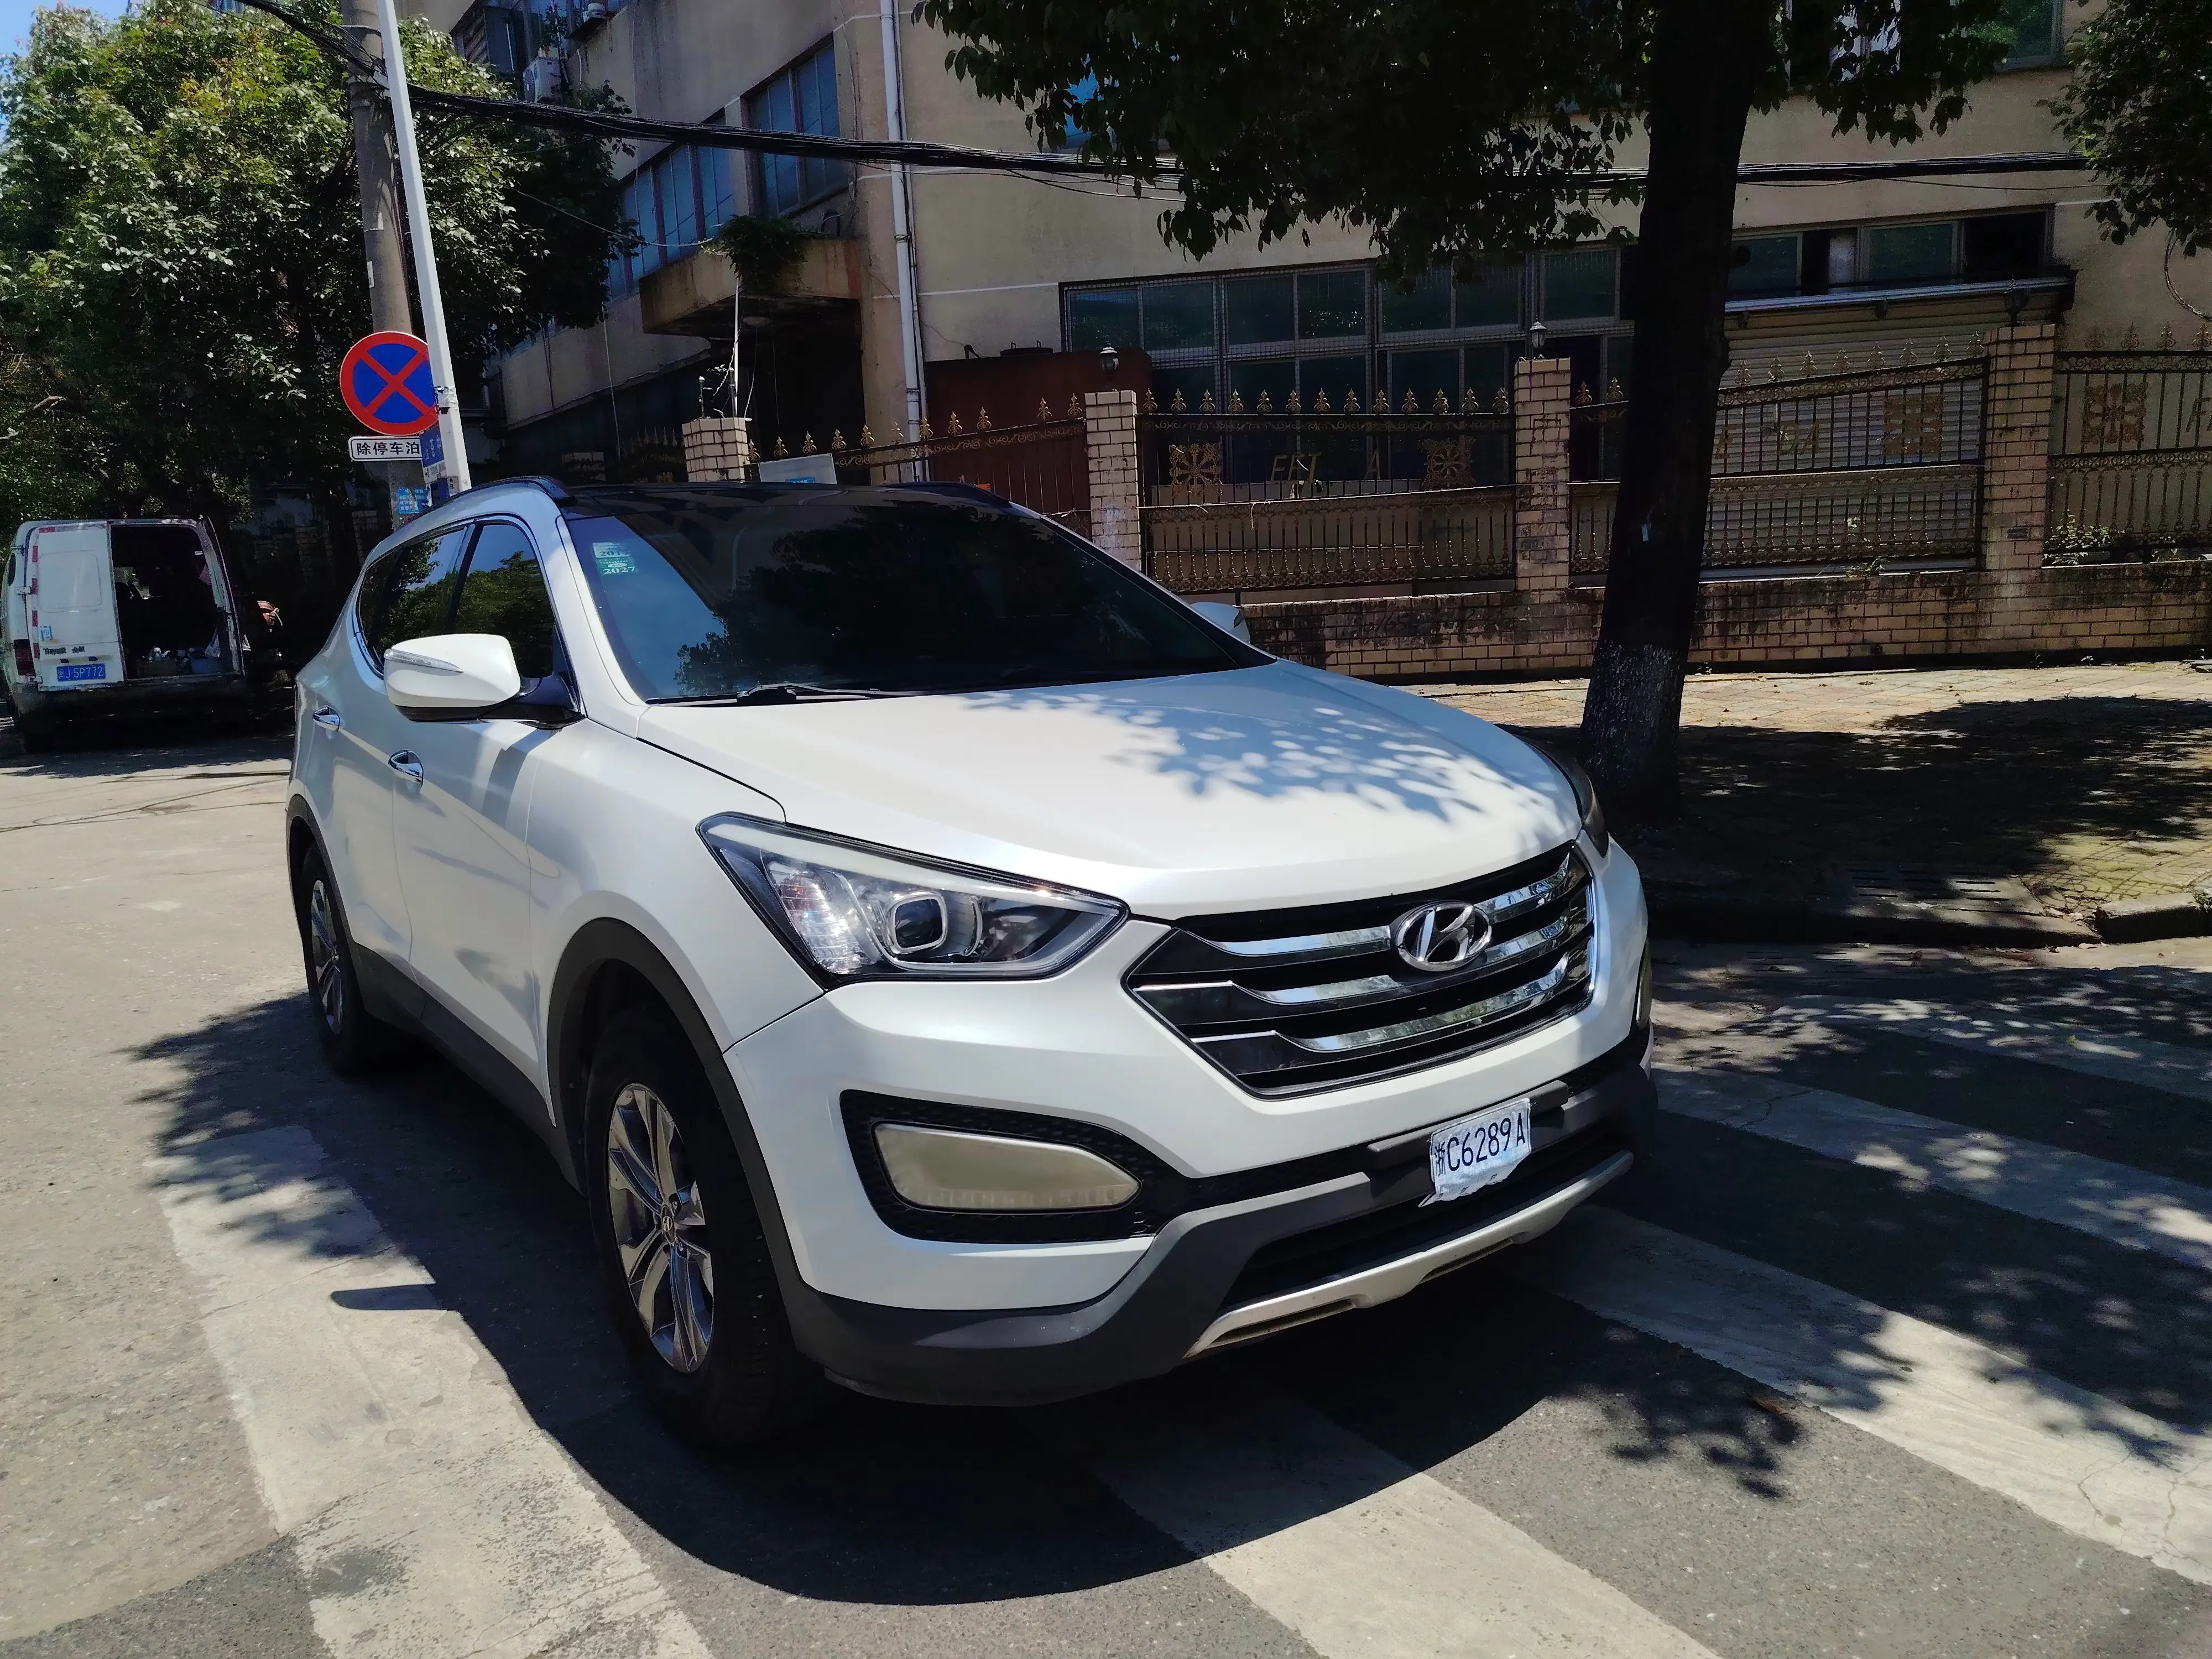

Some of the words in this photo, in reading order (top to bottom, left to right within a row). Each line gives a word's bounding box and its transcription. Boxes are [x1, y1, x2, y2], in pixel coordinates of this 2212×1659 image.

[356, 442, 420, 455] 除停车泊
[603, 566, 635, 575] 2027
